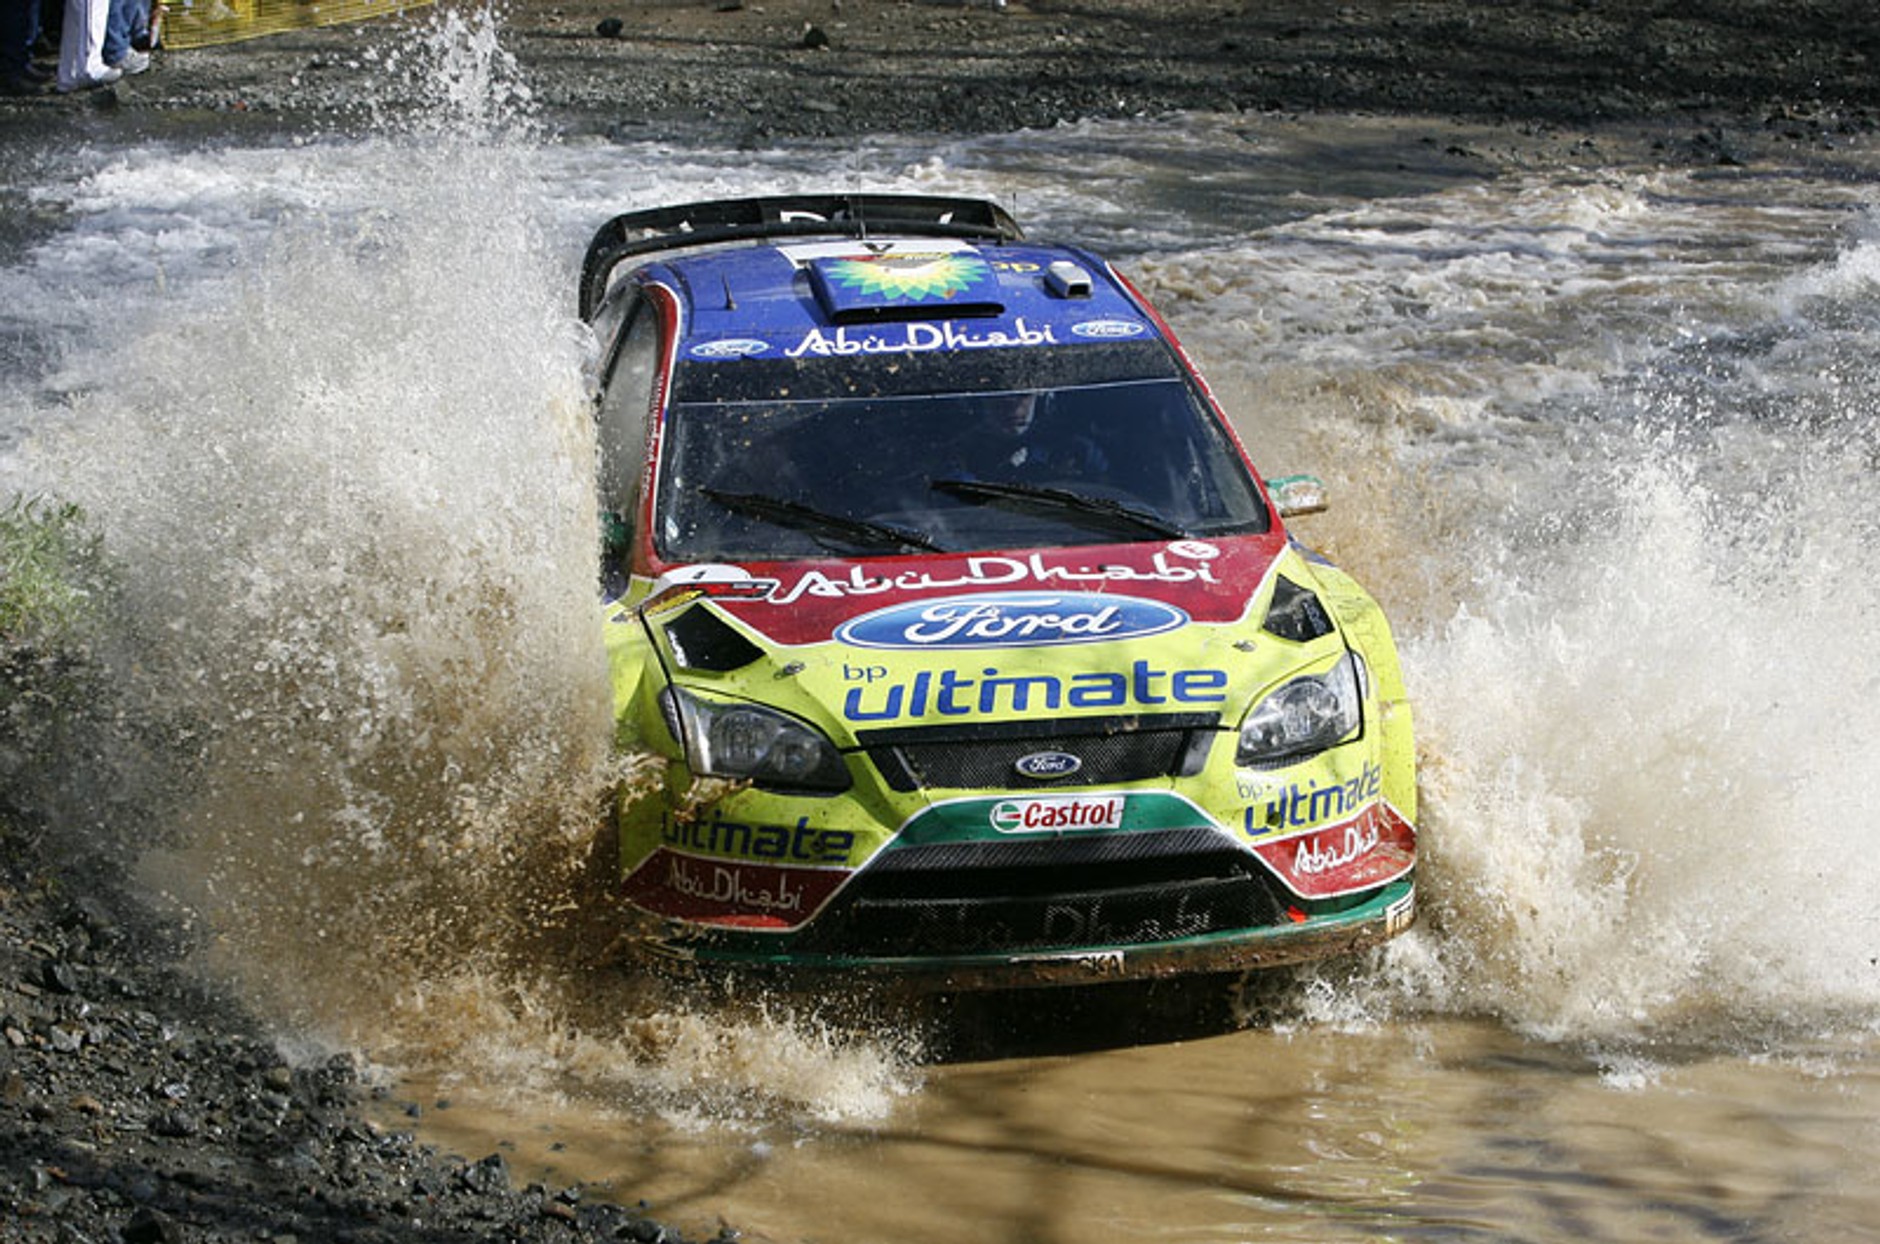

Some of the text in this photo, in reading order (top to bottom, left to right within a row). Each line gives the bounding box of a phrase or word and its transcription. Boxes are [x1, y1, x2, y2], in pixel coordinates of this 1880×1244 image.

[902, 598, 1124, 644] Ford
[843, 663, 888, 683] bp
[843, 660, 1228, 722] ultimate
[1024, 799, 1115, 829] Castrol
[1245, 760, 1381, 837] ultimate
